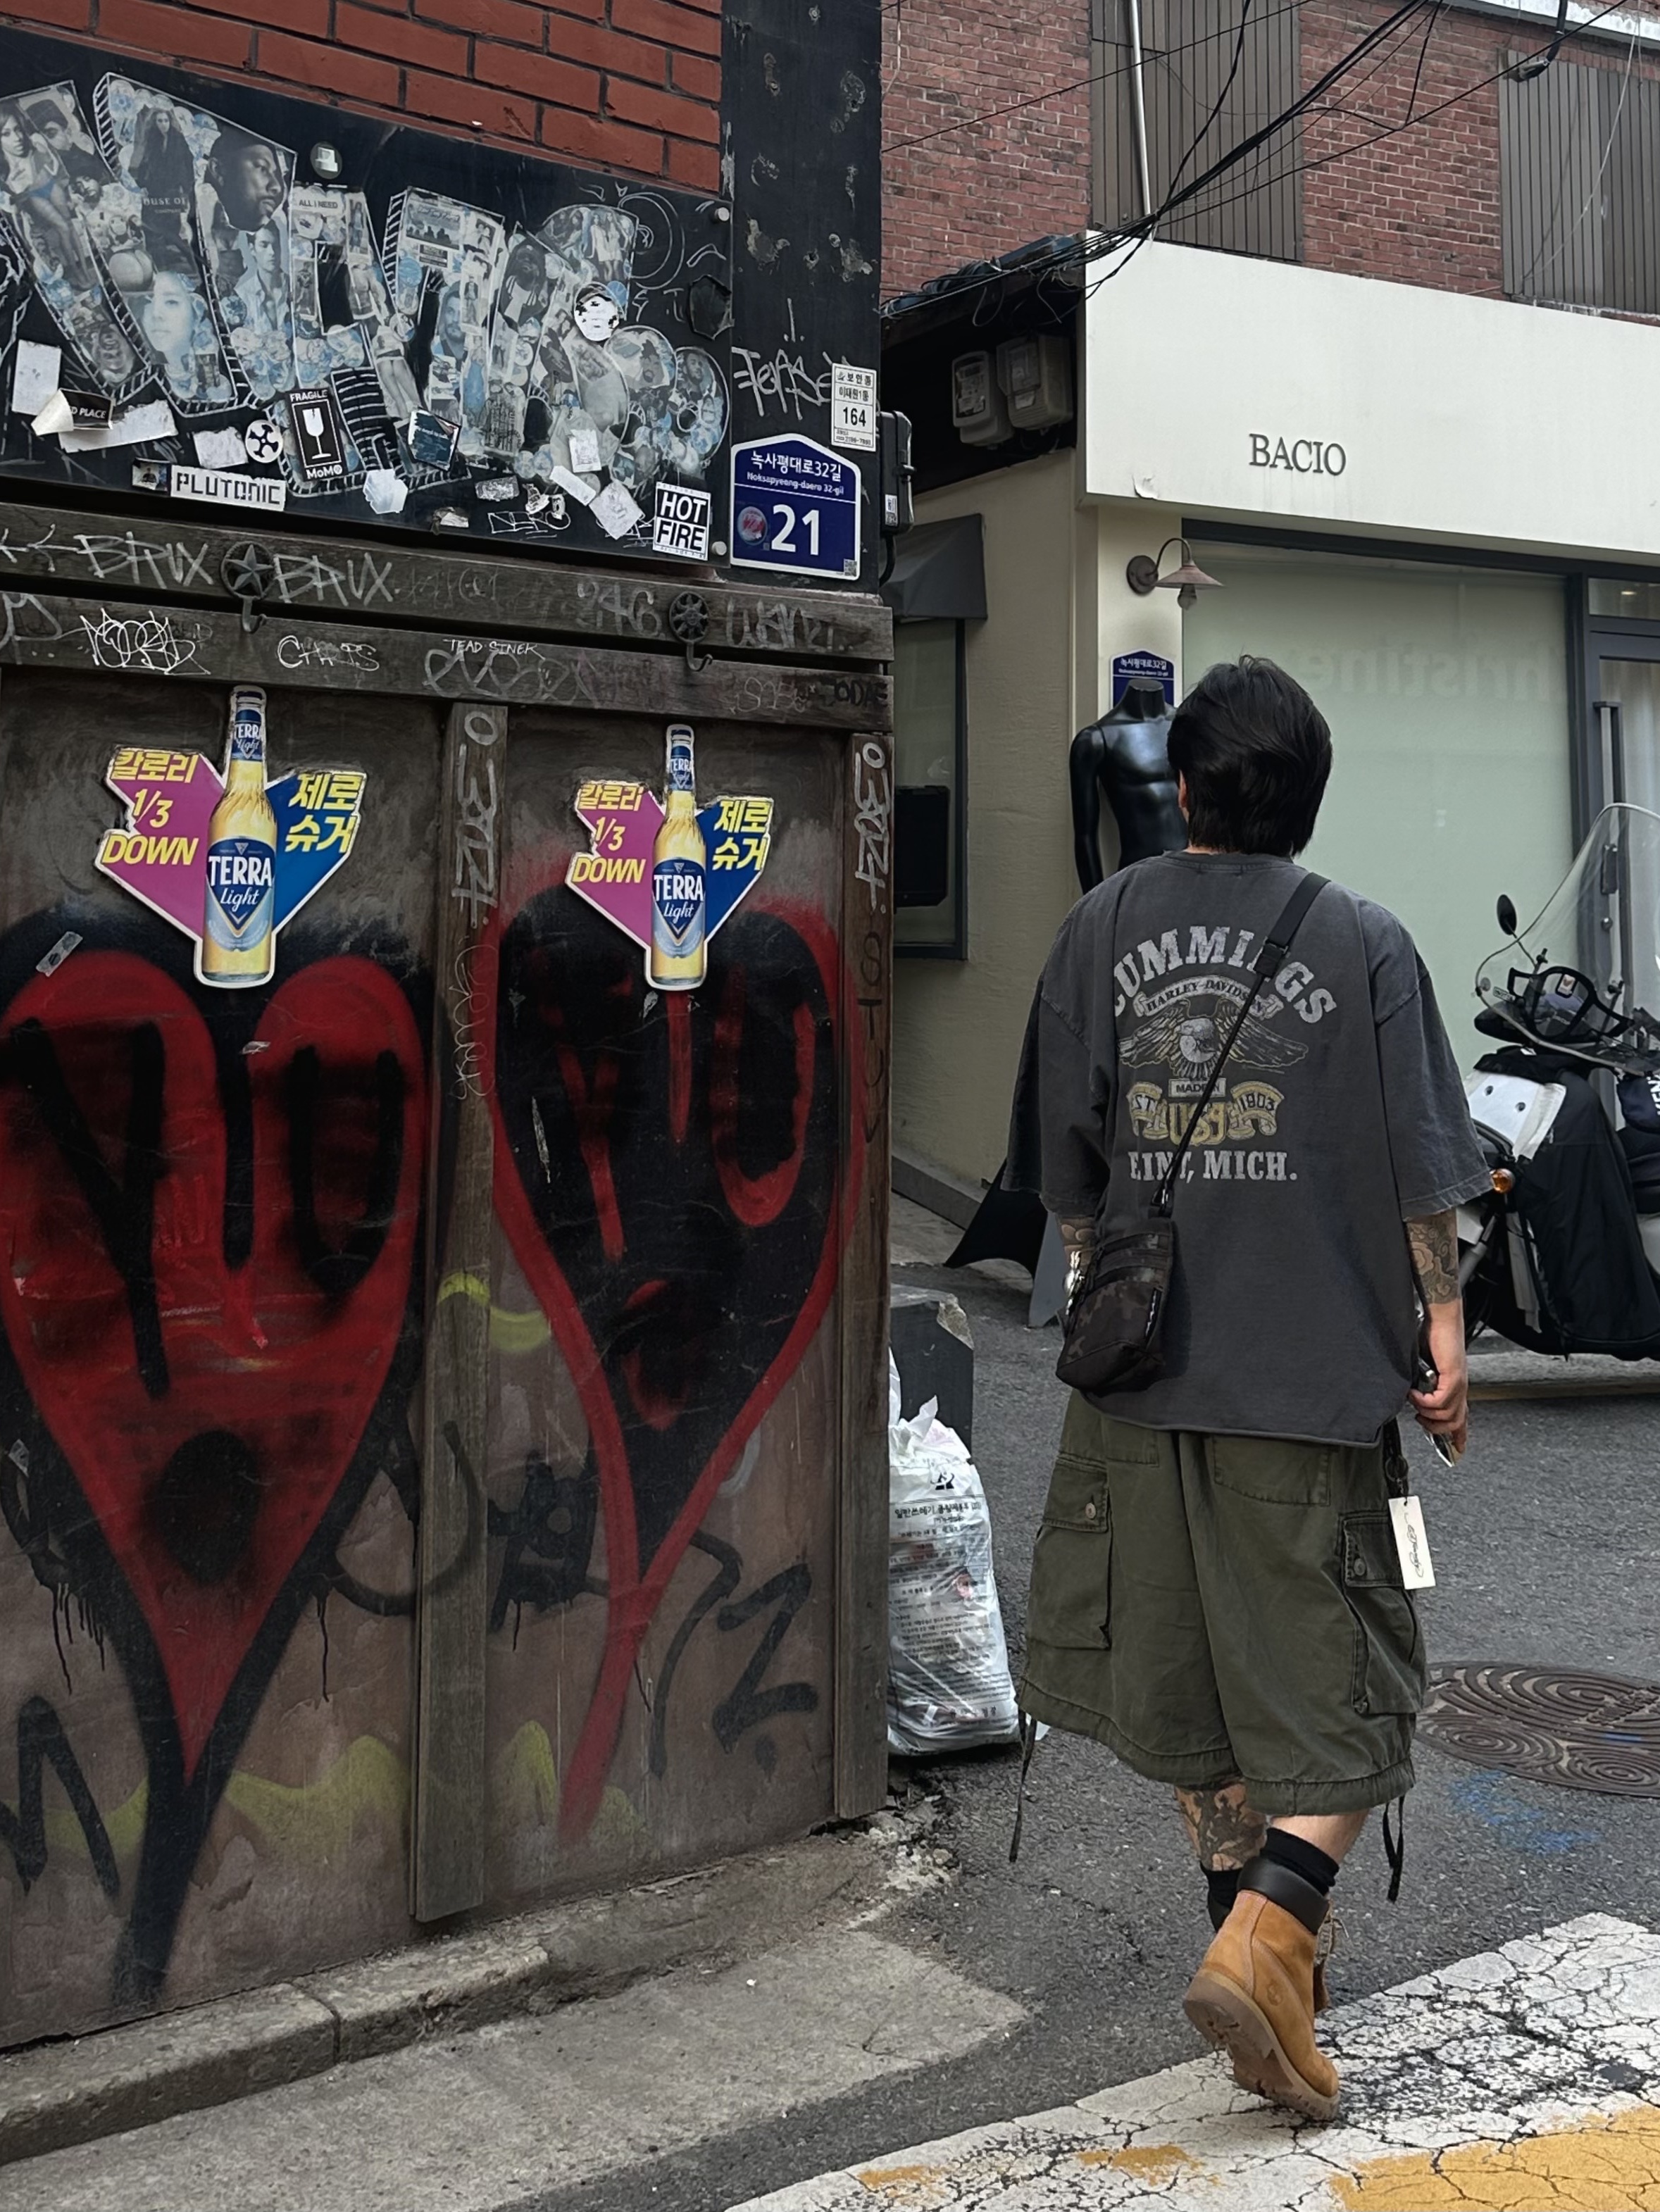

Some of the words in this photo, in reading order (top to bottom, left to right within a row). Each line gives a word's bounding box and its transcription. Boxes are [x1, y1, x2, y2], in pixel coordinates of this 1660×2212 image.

[289, 389, 328, 402] FRAGILE
[79, 407, 106, 419] PLACE
[843, 406, 866, 427] 164
[750, 450, 842, 482] 녹사평대로32길
[1248, 433, 1347, 477] BACIO
[175, 473, 282, 506] PLUTONIC
[747, 471, 823, 492] Noksapyeong-daero
[823, 484, 844, 496] 32-gil
[660, 491, 707, 523] HOT
[656, 520, 705, 551] FIRE
[771, 504, 820, 556] 21
[110, 749, 200, 783] 칼로리
[288, 772, 364, 811] 제로
[580, 782, 644, 811] 칼로리
[132, 788, 170, 829] 1/3
[714, 800, 772, 833] 제로
[101, 834, 200, 866] DOWN
[284, 815, 358, 853] 슈거
[594, 816, 625, 852] 1/3
[571, 855, 647, 885] DOWN
[713, 837, 768, 871] 슈거
[208, 855, 273, 887] TERRA
[220, 887, 260, 913] Light
[653, 874, 704, 902] TERRA
[663, 901, 694, 924] Light
[1241, 1093, 1276, 1112] 1903
[1202, 1149, 1297, 1182] MICH.
